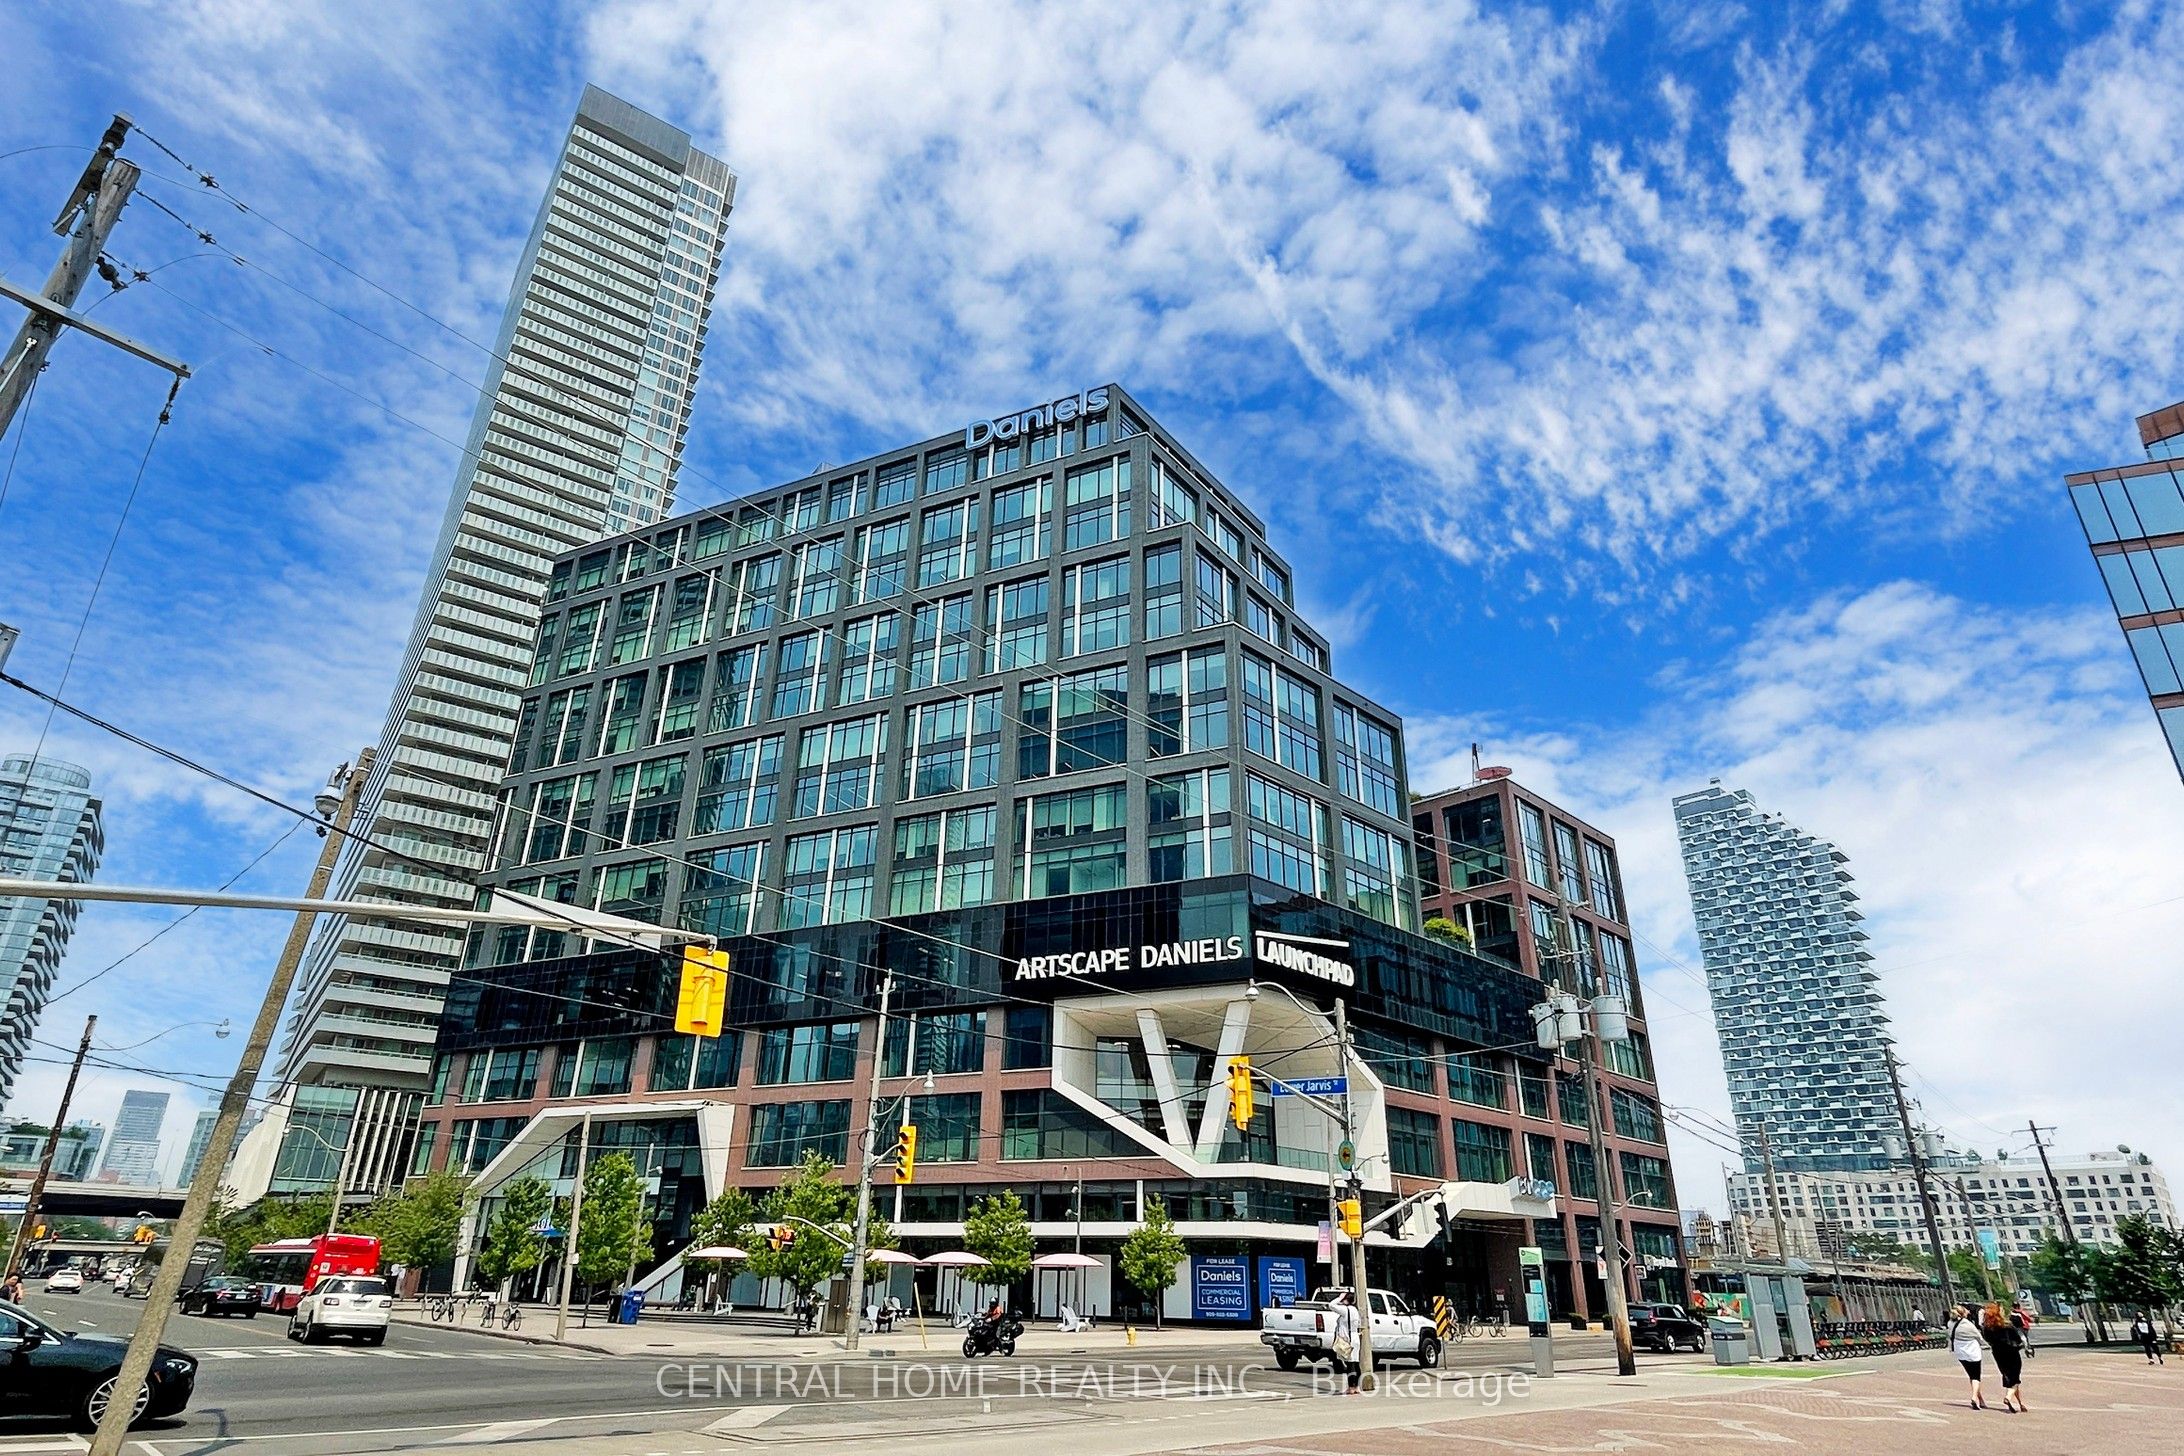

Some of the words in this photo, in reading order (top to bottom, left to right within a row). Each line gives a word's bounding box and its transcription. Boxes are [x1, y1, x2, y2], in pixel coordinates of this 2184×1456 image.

[965, 387, 1110, 449] Daniels
[1015, 947, 1130, 981] ARTSCAPE
[1141, 936, 1243, 968] DANIELS
[1255, 937, 1355, 987] LAUNCHPAD
[1306, 1080, 1332, 1092] Jarvis
[1201, 1270, 1241, 1281] Daniels
[1271, 1272, 1293, 1283] Daniels
[1201, 1296, 1242, 1305] LEASING
